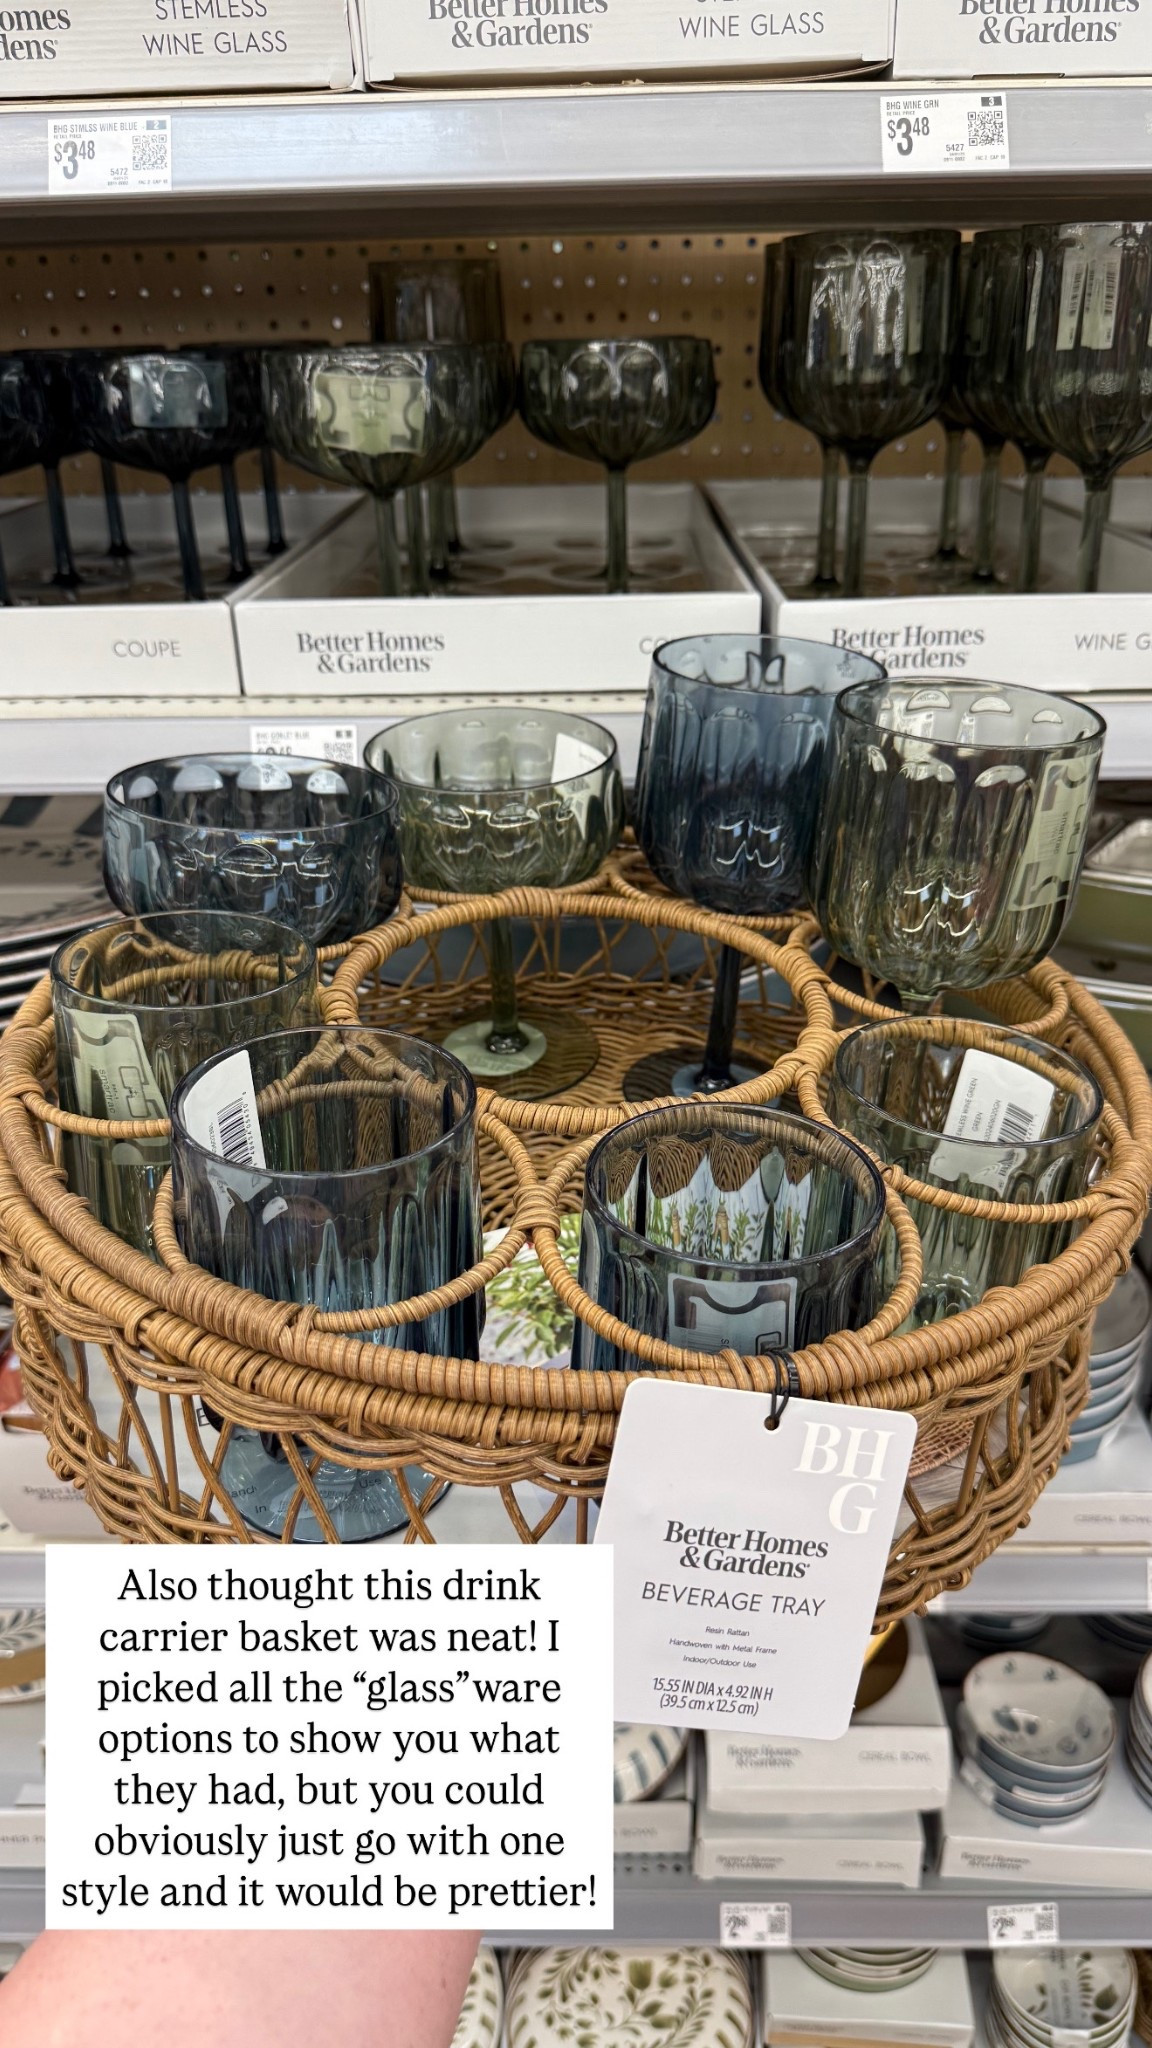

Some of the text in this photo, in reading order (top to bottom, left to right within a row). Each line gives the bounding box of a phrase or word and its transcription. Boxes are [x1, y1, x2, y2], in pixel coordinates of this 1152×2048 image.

[0, 9, 71, 31] omes
[156, 0, 267, 20] STEMLESS
[679, 12, 824, 38] WINE GLASS
[142, 31, 287, 55] WINE GLASS
[886, 99, 940, 110] BHG WINE GRN
[53, 125, 68, 133] BHG
[100, 122, 118, 131] WINE
[120, 122, 138, 130] BLUE
[946, 144, 964, 152] 5427
[110, 167, 128, 176] 5472
[297, 631, 445, 652] Better Homes
[832, 625, 985, 648] Better Homes
[1075, 633, 1126, 651] WINE
[113, 640, 182, 657] COUPE
[870, 648, 966, 669] Gardens
[663, 1520, 828, 1558] Better Homes
[642, 1581, 826, 1617] BEVERAGE TRAY
[705, 1626, 750, 1637] Resin Rattan
[669, 1638, 712, 1649] Handwoven
[732, 1644, 752, 1653] Metal
[755, 1646, 777, 1655] Frame
[683, 1655, 757, 1669] Indoor/Outdoor Use
[653, 1677, 774, 1701] 15.55 IN DIA x 4.92 IN H
[660, 1693, 759, 1717] (39.5 cm x 12.5 cm)
